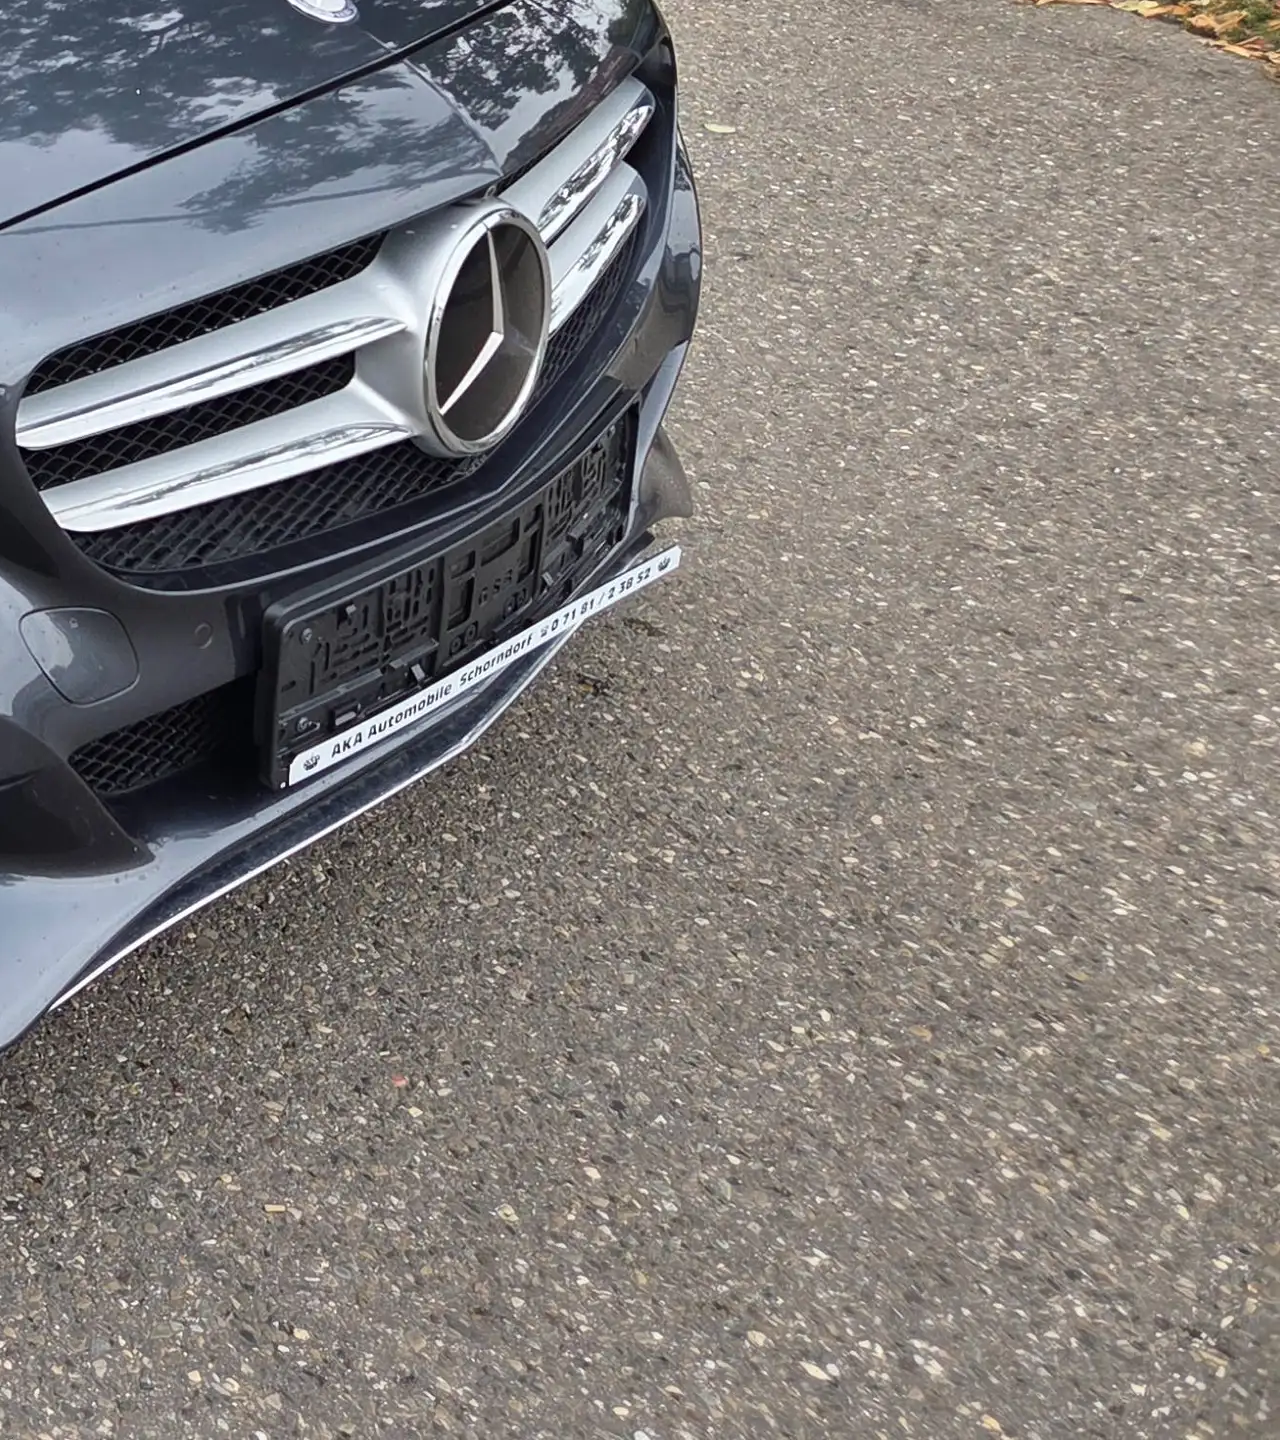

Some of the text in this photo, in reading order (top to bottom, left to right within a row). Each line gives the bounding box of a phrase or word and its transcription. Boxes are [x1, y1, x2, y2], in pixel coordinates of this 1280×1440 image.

[331, 731, 363, 758] AKA
[368, 683, 452, 739] Automobile
[459, 633, 533, 687] Schorndorf
[562, 608, 576, 627] 71
[580, 598, 595, 615] 81
[608, 586, 616, 600] 2
[618, 577, 633, 593] 38
[637, 567, 651, 582] 52
